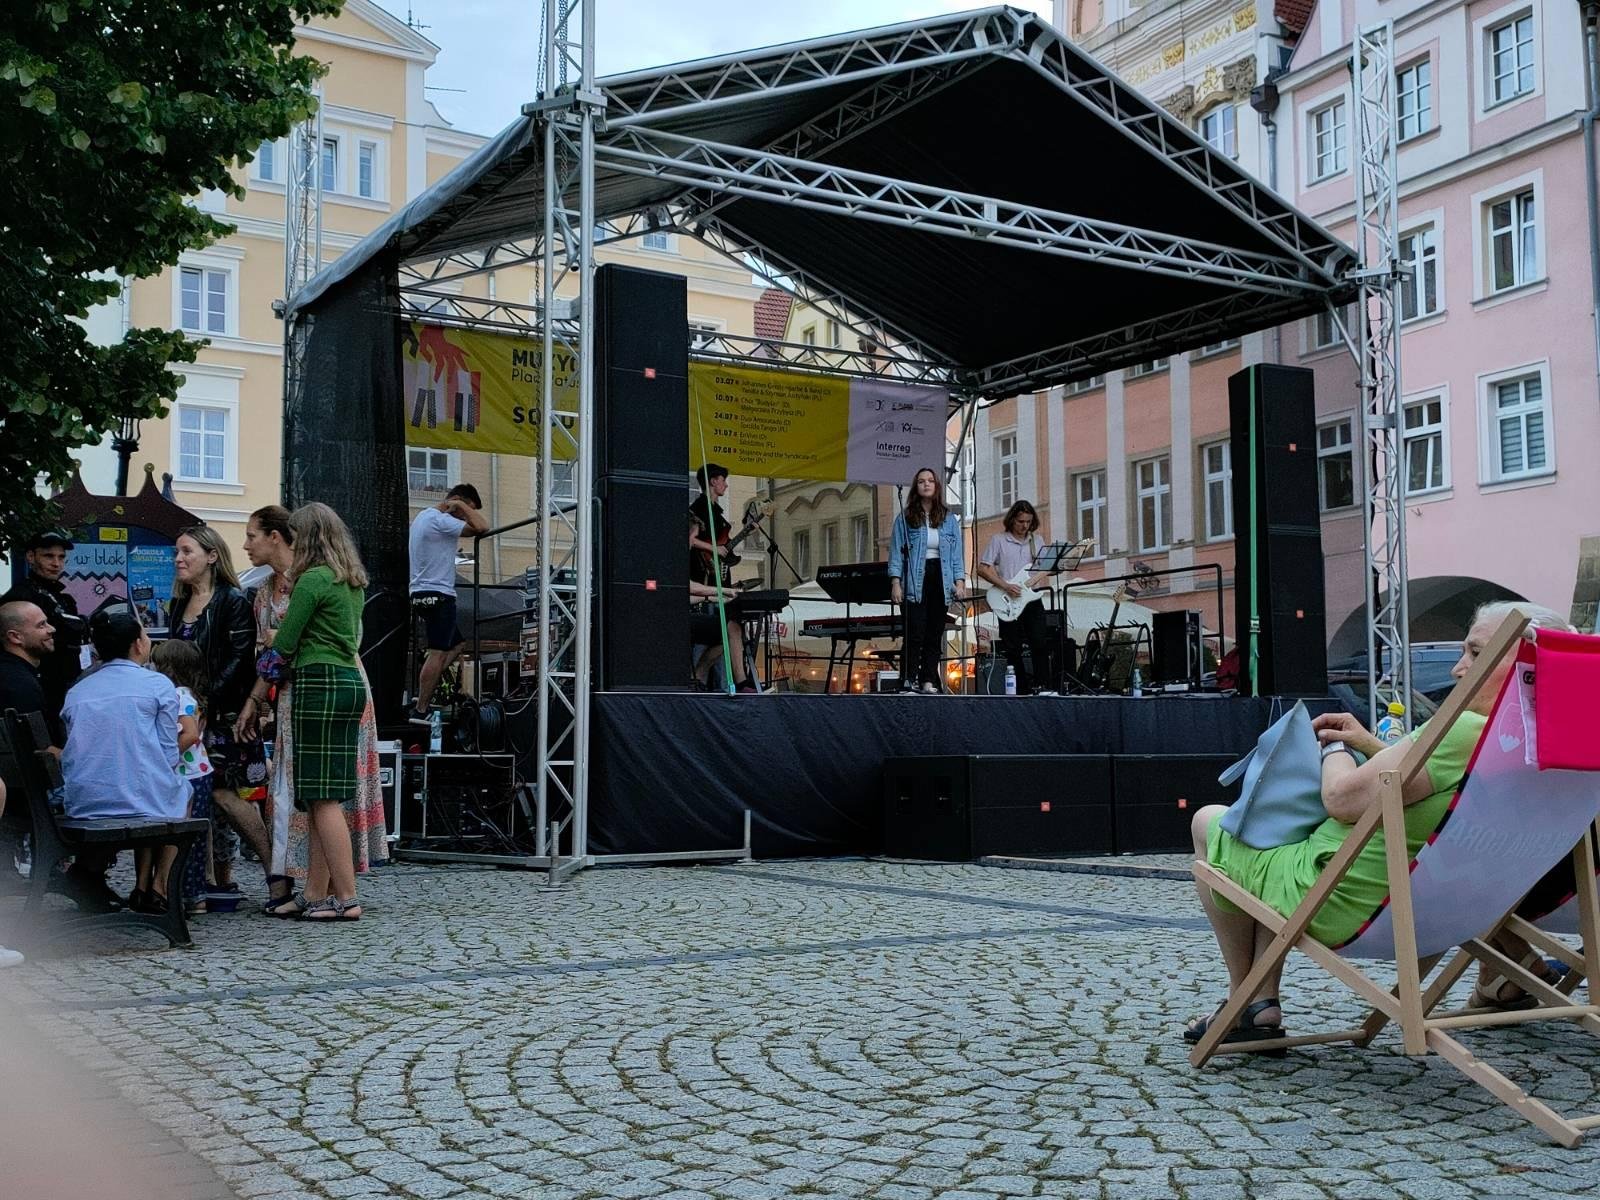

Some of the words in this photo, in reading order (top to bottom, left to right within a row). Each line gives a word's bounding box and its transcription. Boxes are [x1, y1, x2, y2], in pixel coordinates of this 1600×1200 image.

[715, 394, 734, 403] 10.07
[714, 411, 733, 420] 24.07
[713, 428, 732, 437] 31.07
[713, 445, 732, 454] 07.08
[876, 440, 911, 454] Interreg
[95, 548, 125, 565] blok
